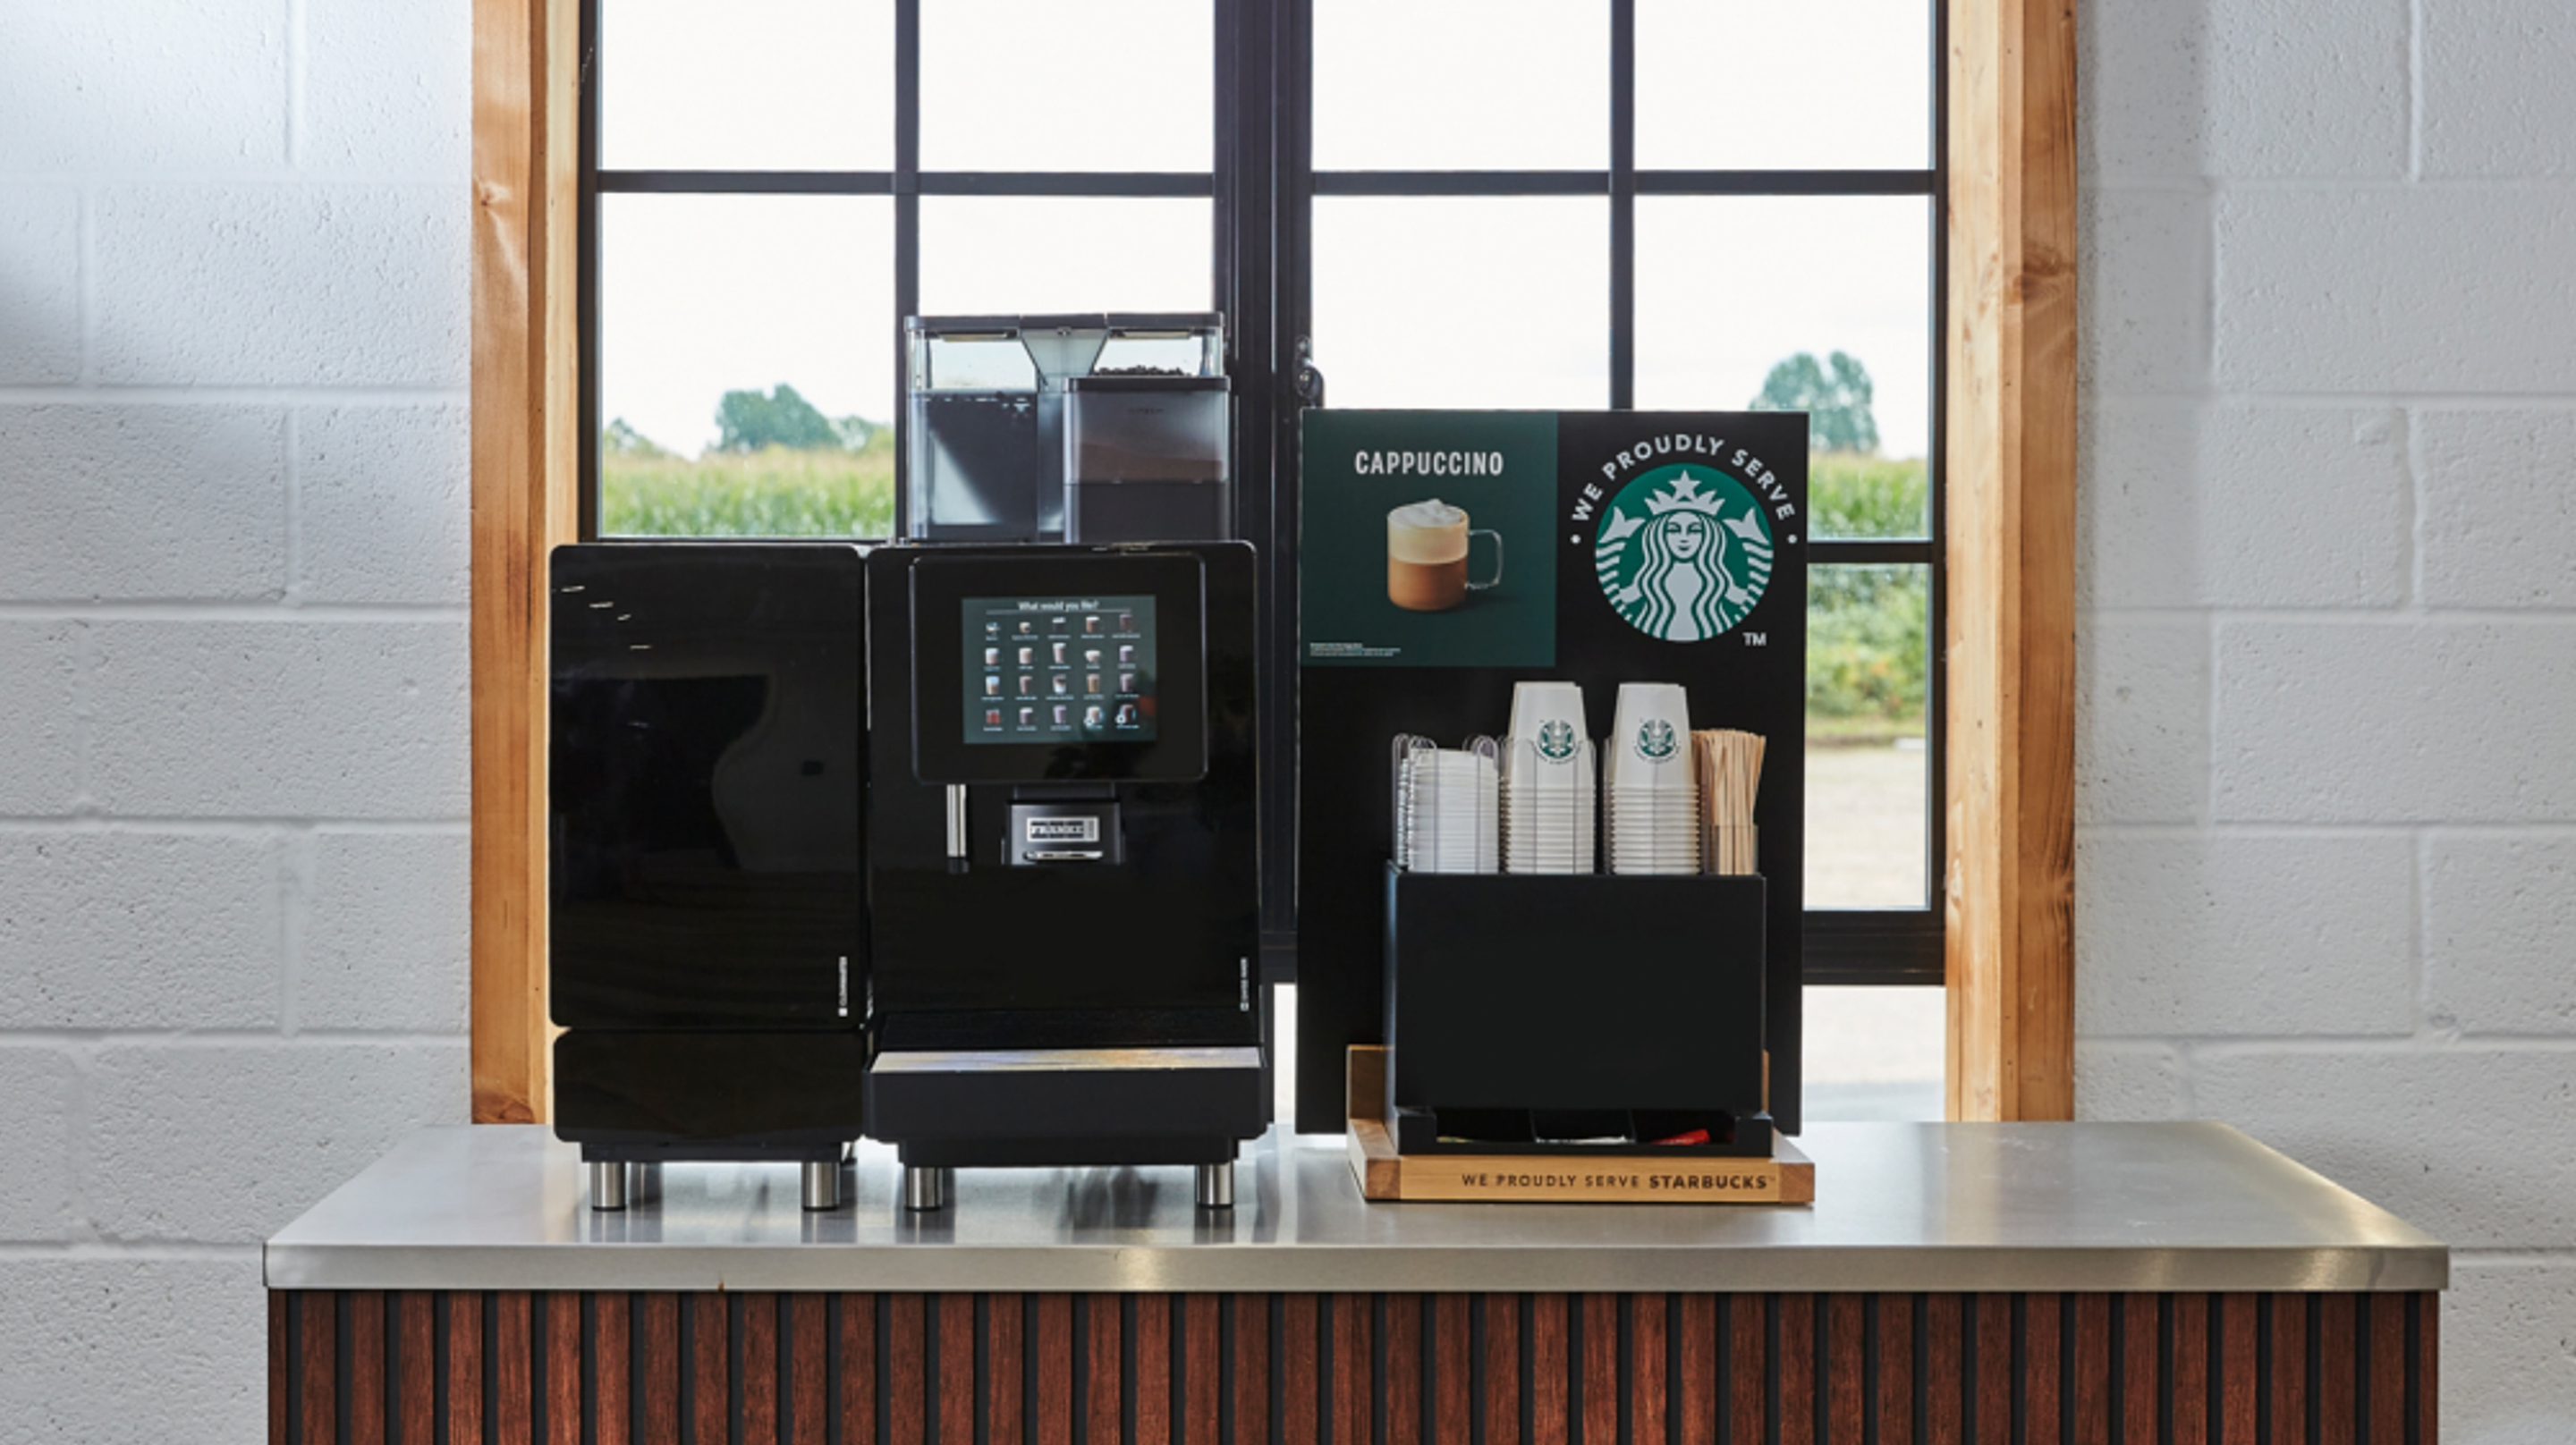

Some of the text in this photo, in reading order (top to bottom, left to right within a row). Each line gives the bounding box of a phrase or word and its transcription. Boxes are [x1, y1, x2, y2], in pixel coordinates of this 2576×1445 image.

[1355, 451, 1504, 476] CAPPUCCINO
[1572, 434, 1795, 520] WE PROUDLY SERVE
[1742, 632, 1767, 646] TM
[1462, 1174, 1768, 1189] WE PROUDLY SERVE STARBUCKS
